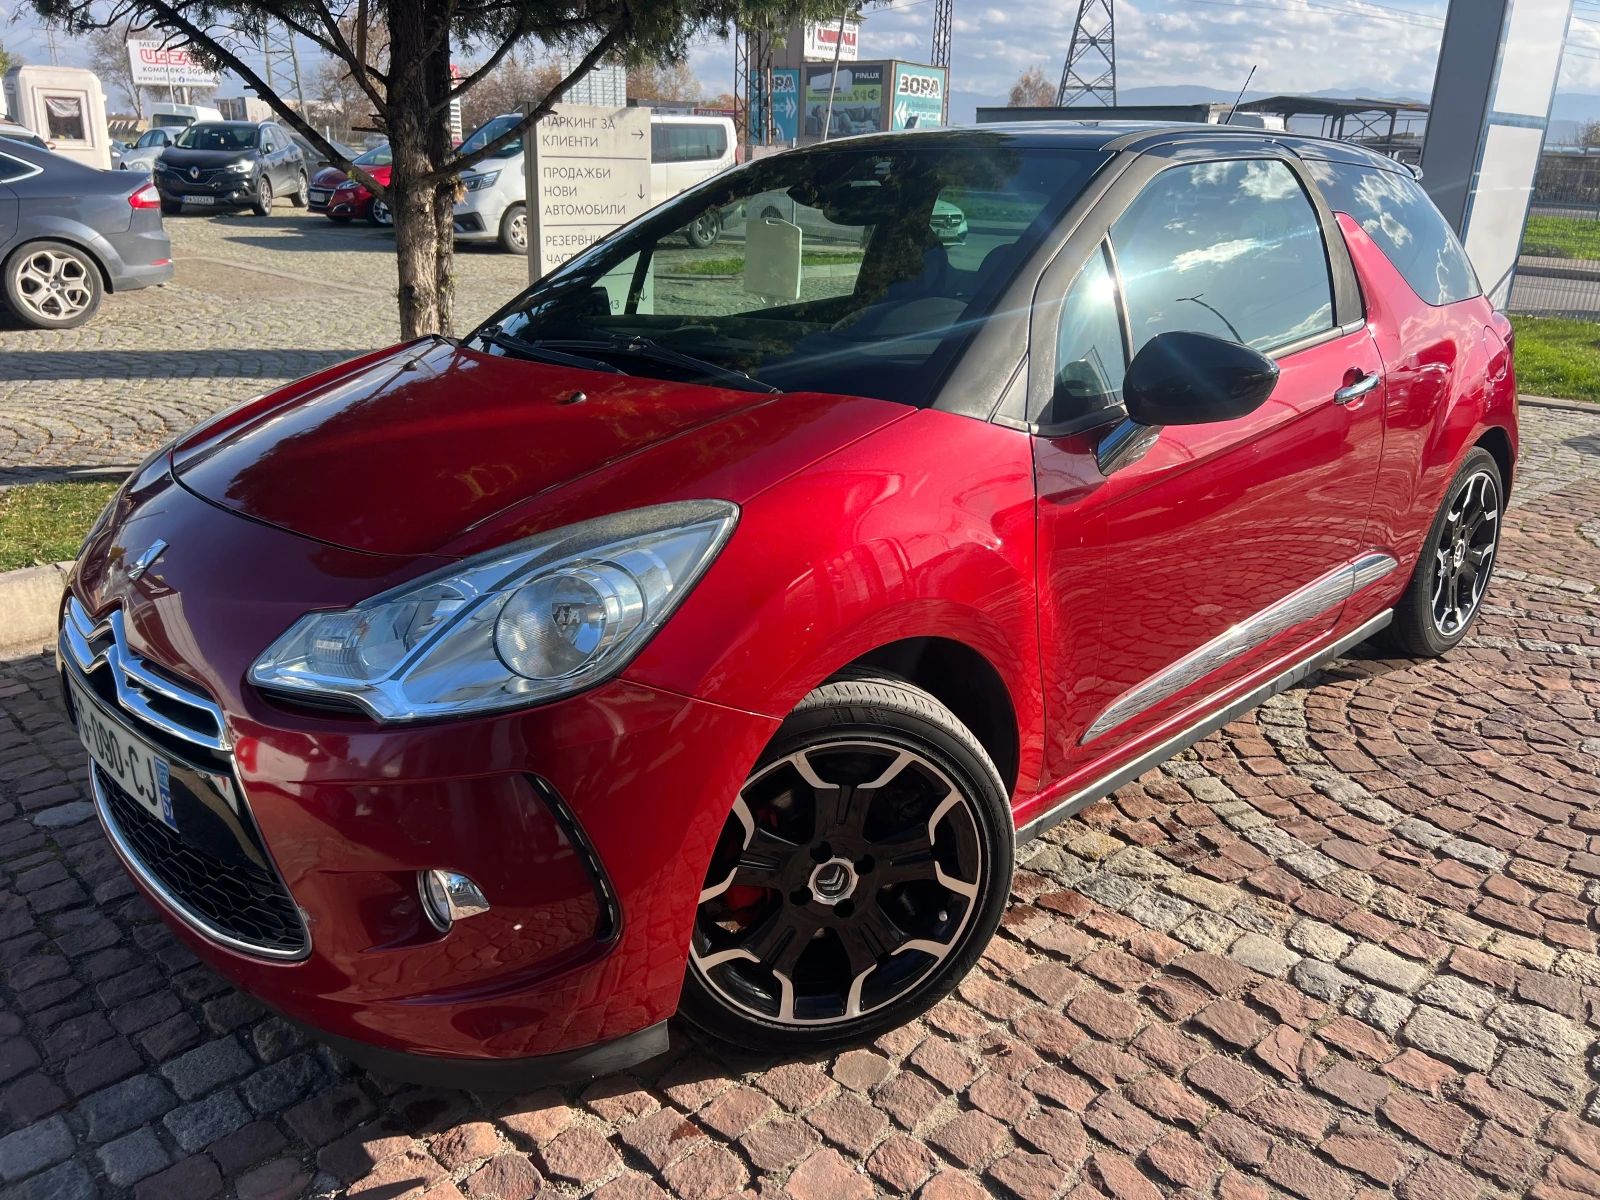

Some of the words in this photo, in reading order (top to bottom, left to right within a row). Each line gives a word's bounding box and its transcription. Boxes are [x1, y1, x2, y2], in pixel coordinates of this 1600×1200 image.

[898, 74, 941, 99] ЗОРА
[542, 115, 598, 129] ПАРКИНГ
[601, 118, 616, 130] ЗА
[542, 135, 599, 148] КЛИЕНТИ
[543, 167, 611, 180] ПРОДАЖБИ
[544, 186, 578, 197] НОВИ
[544, 204, 626, 215] АВТОМОБИЛИ
